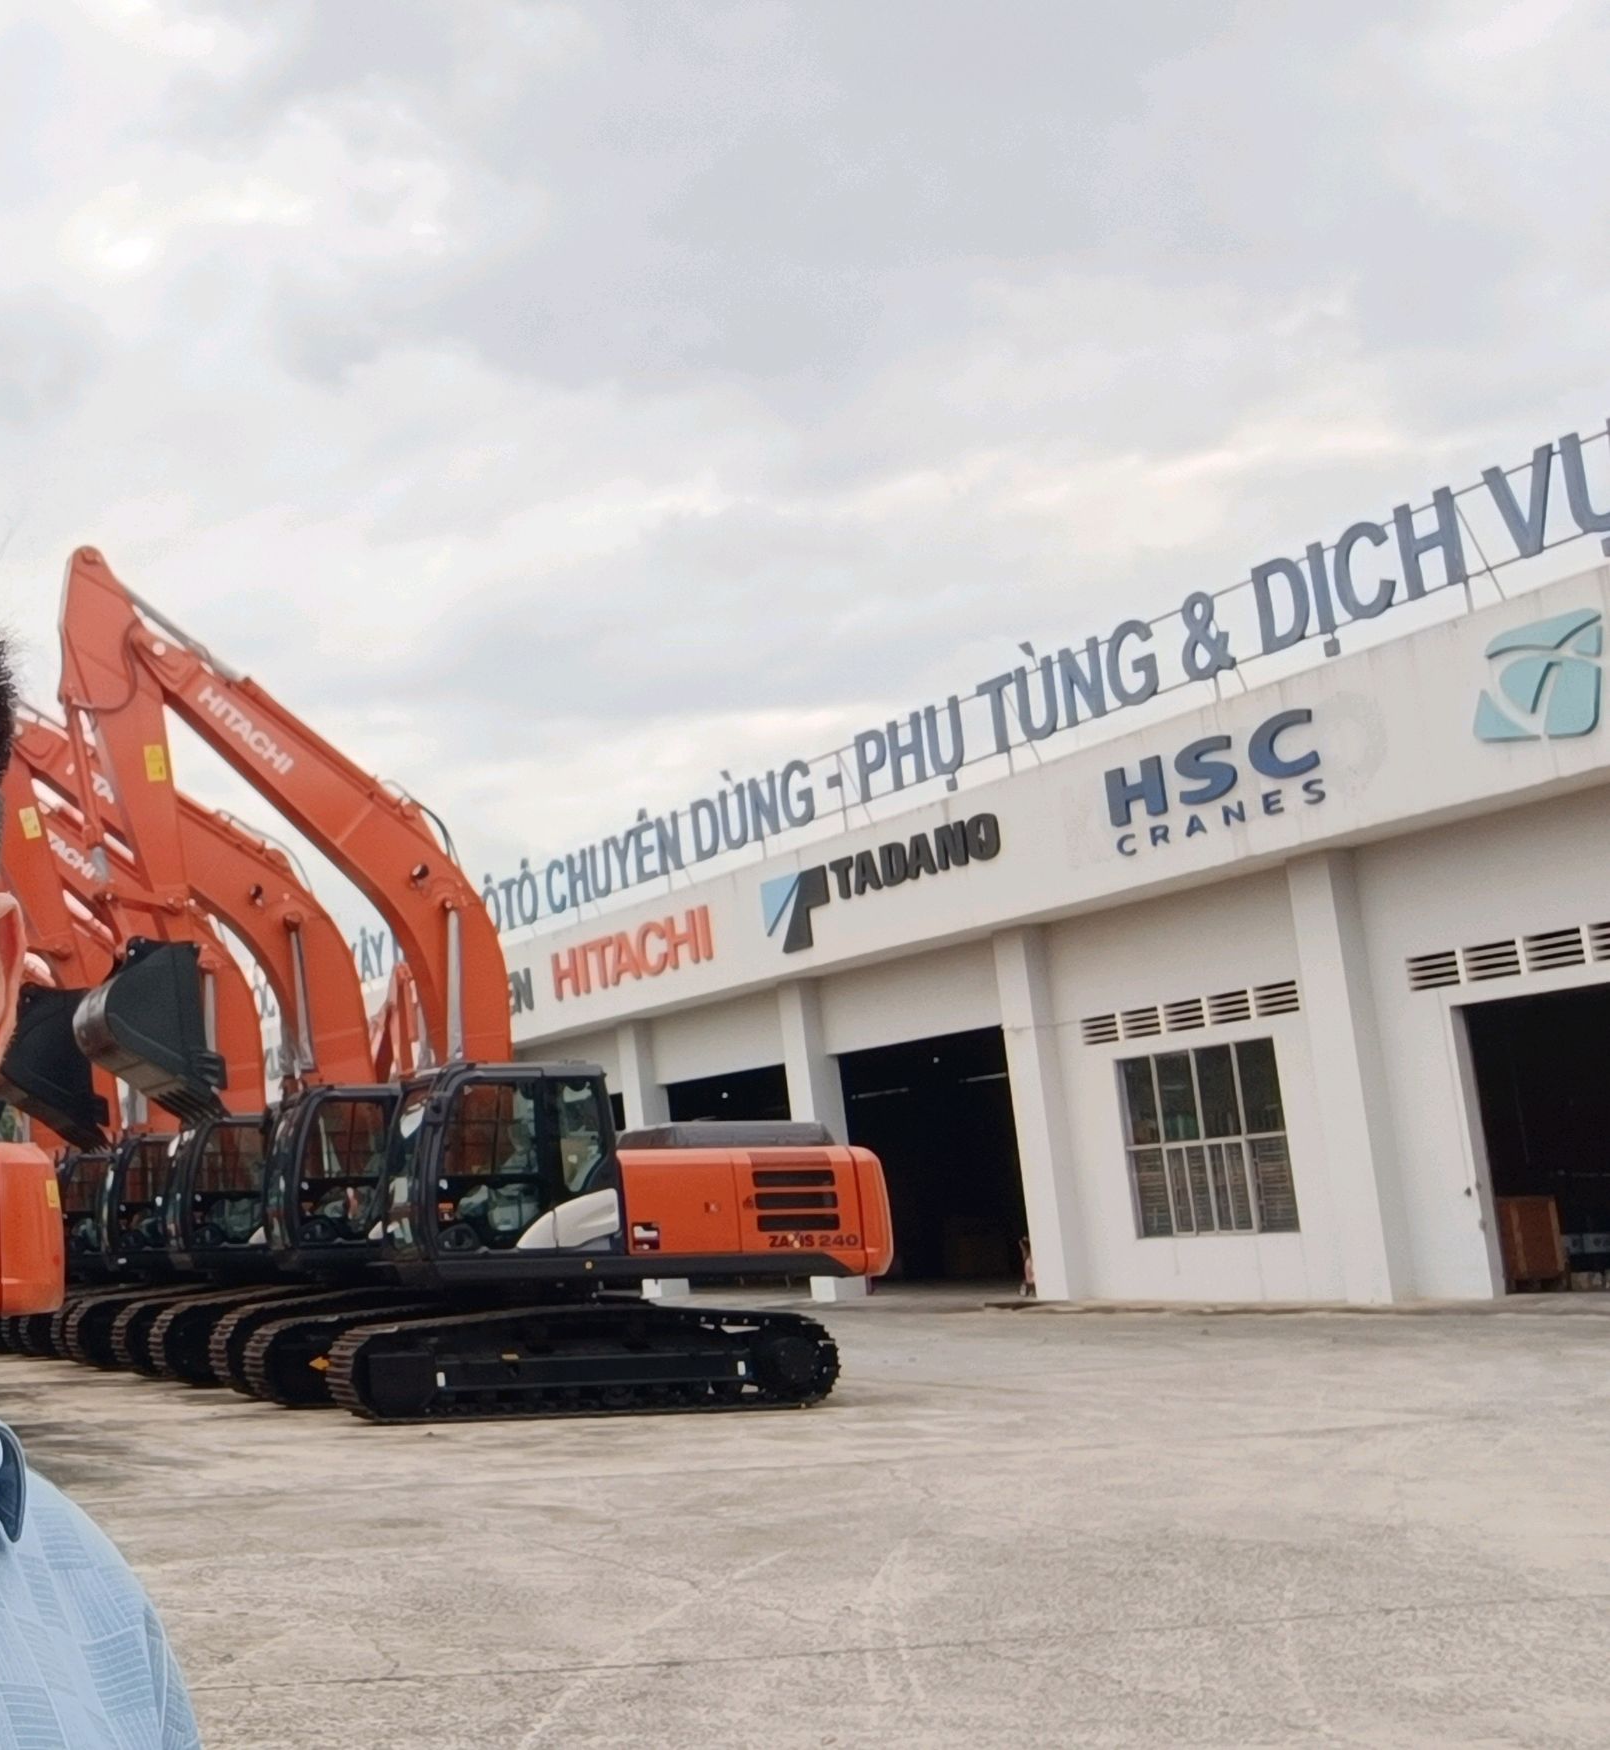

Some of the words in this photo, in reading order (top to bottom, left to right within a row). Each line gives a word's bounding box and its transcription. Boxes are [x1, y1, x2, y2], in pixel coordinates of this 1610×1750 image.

[198, 685, 294, 776] HITACHI
[349, 926, 385, 984] ÂY
[690, 759, 815, 863] DÙNG
[854, 692, 964, 803] PHỤ
[976, 618, 1159, 755] TÙNG
[1181, 591, 1237, 682] &
[1251, 486, 1467, 657] DỊCH
[1481, 417, 1610, 558] VỤ
[1104, 709, 1321, 829] HSC
[829, 812, 1001, 899] TADANO
[1116, 778, 1326, 857] CRANES
[551, 905, 714, 1001] HITACHI
[819, 1233, 859, 1247] 240
